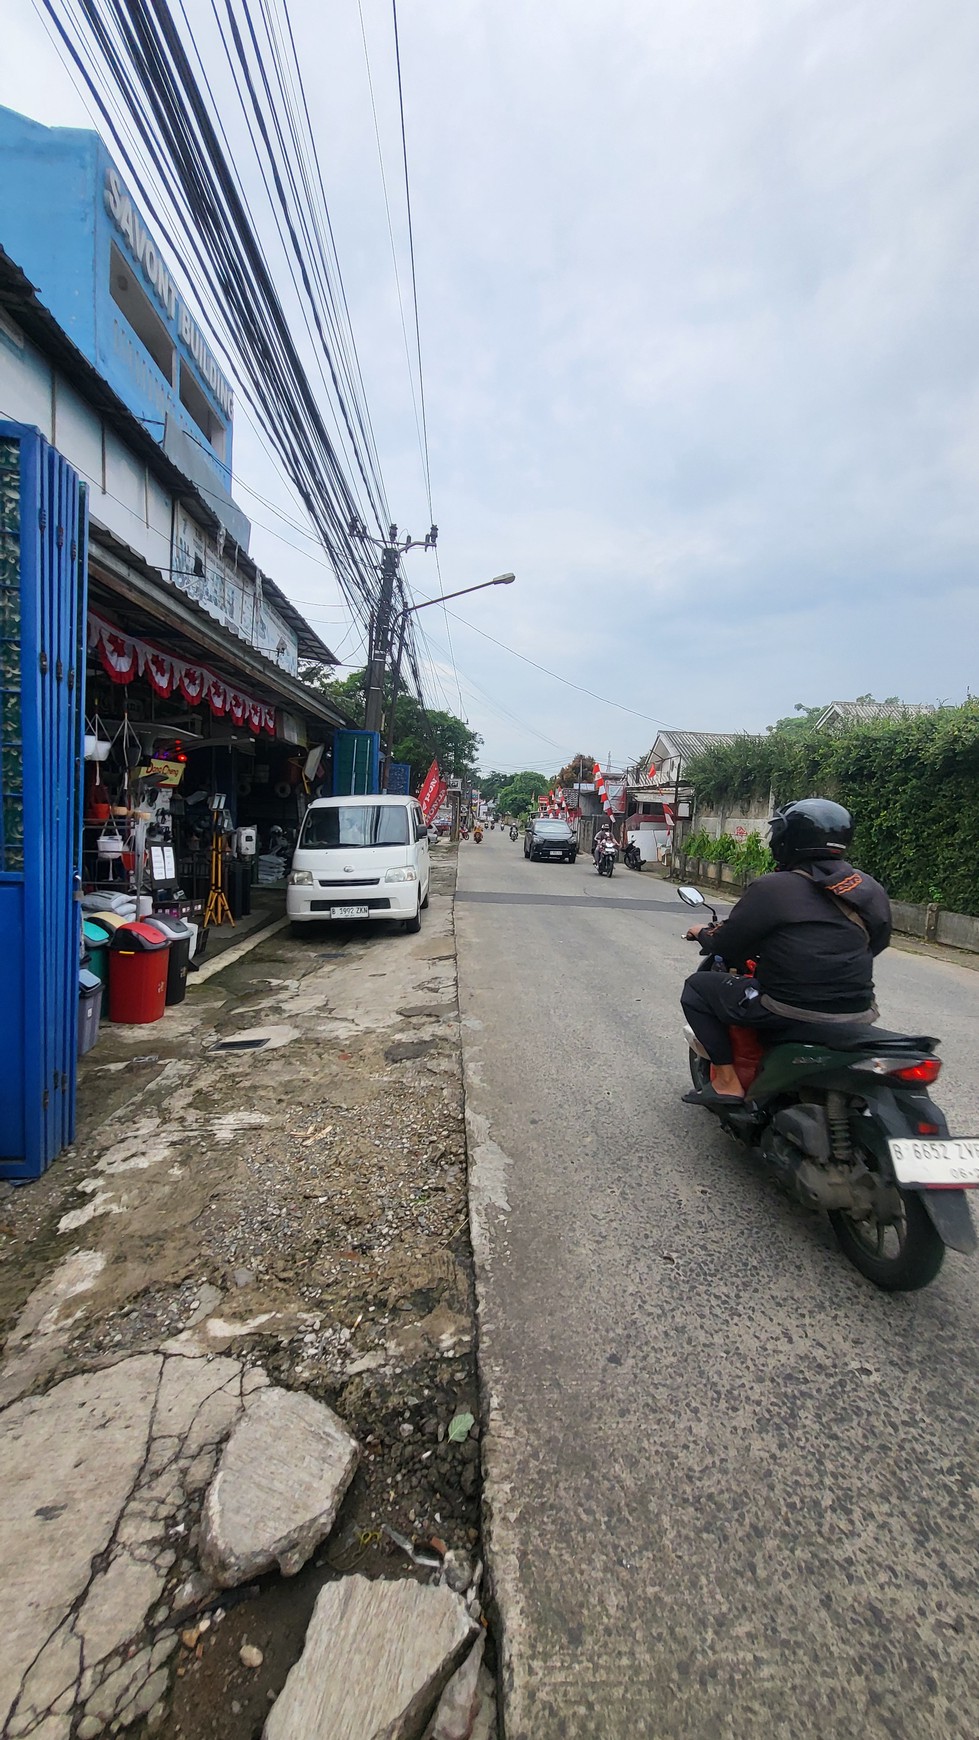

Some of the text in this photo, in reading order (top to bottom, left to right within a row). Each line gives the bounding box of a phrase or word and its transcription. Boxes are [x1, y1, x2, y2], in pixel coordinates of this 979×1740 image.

[103, 168, 235, 421] SAVONT BUILDING
[892, 1143, 903, 1160] B
[912, 1143, 952, 1160] 6652
